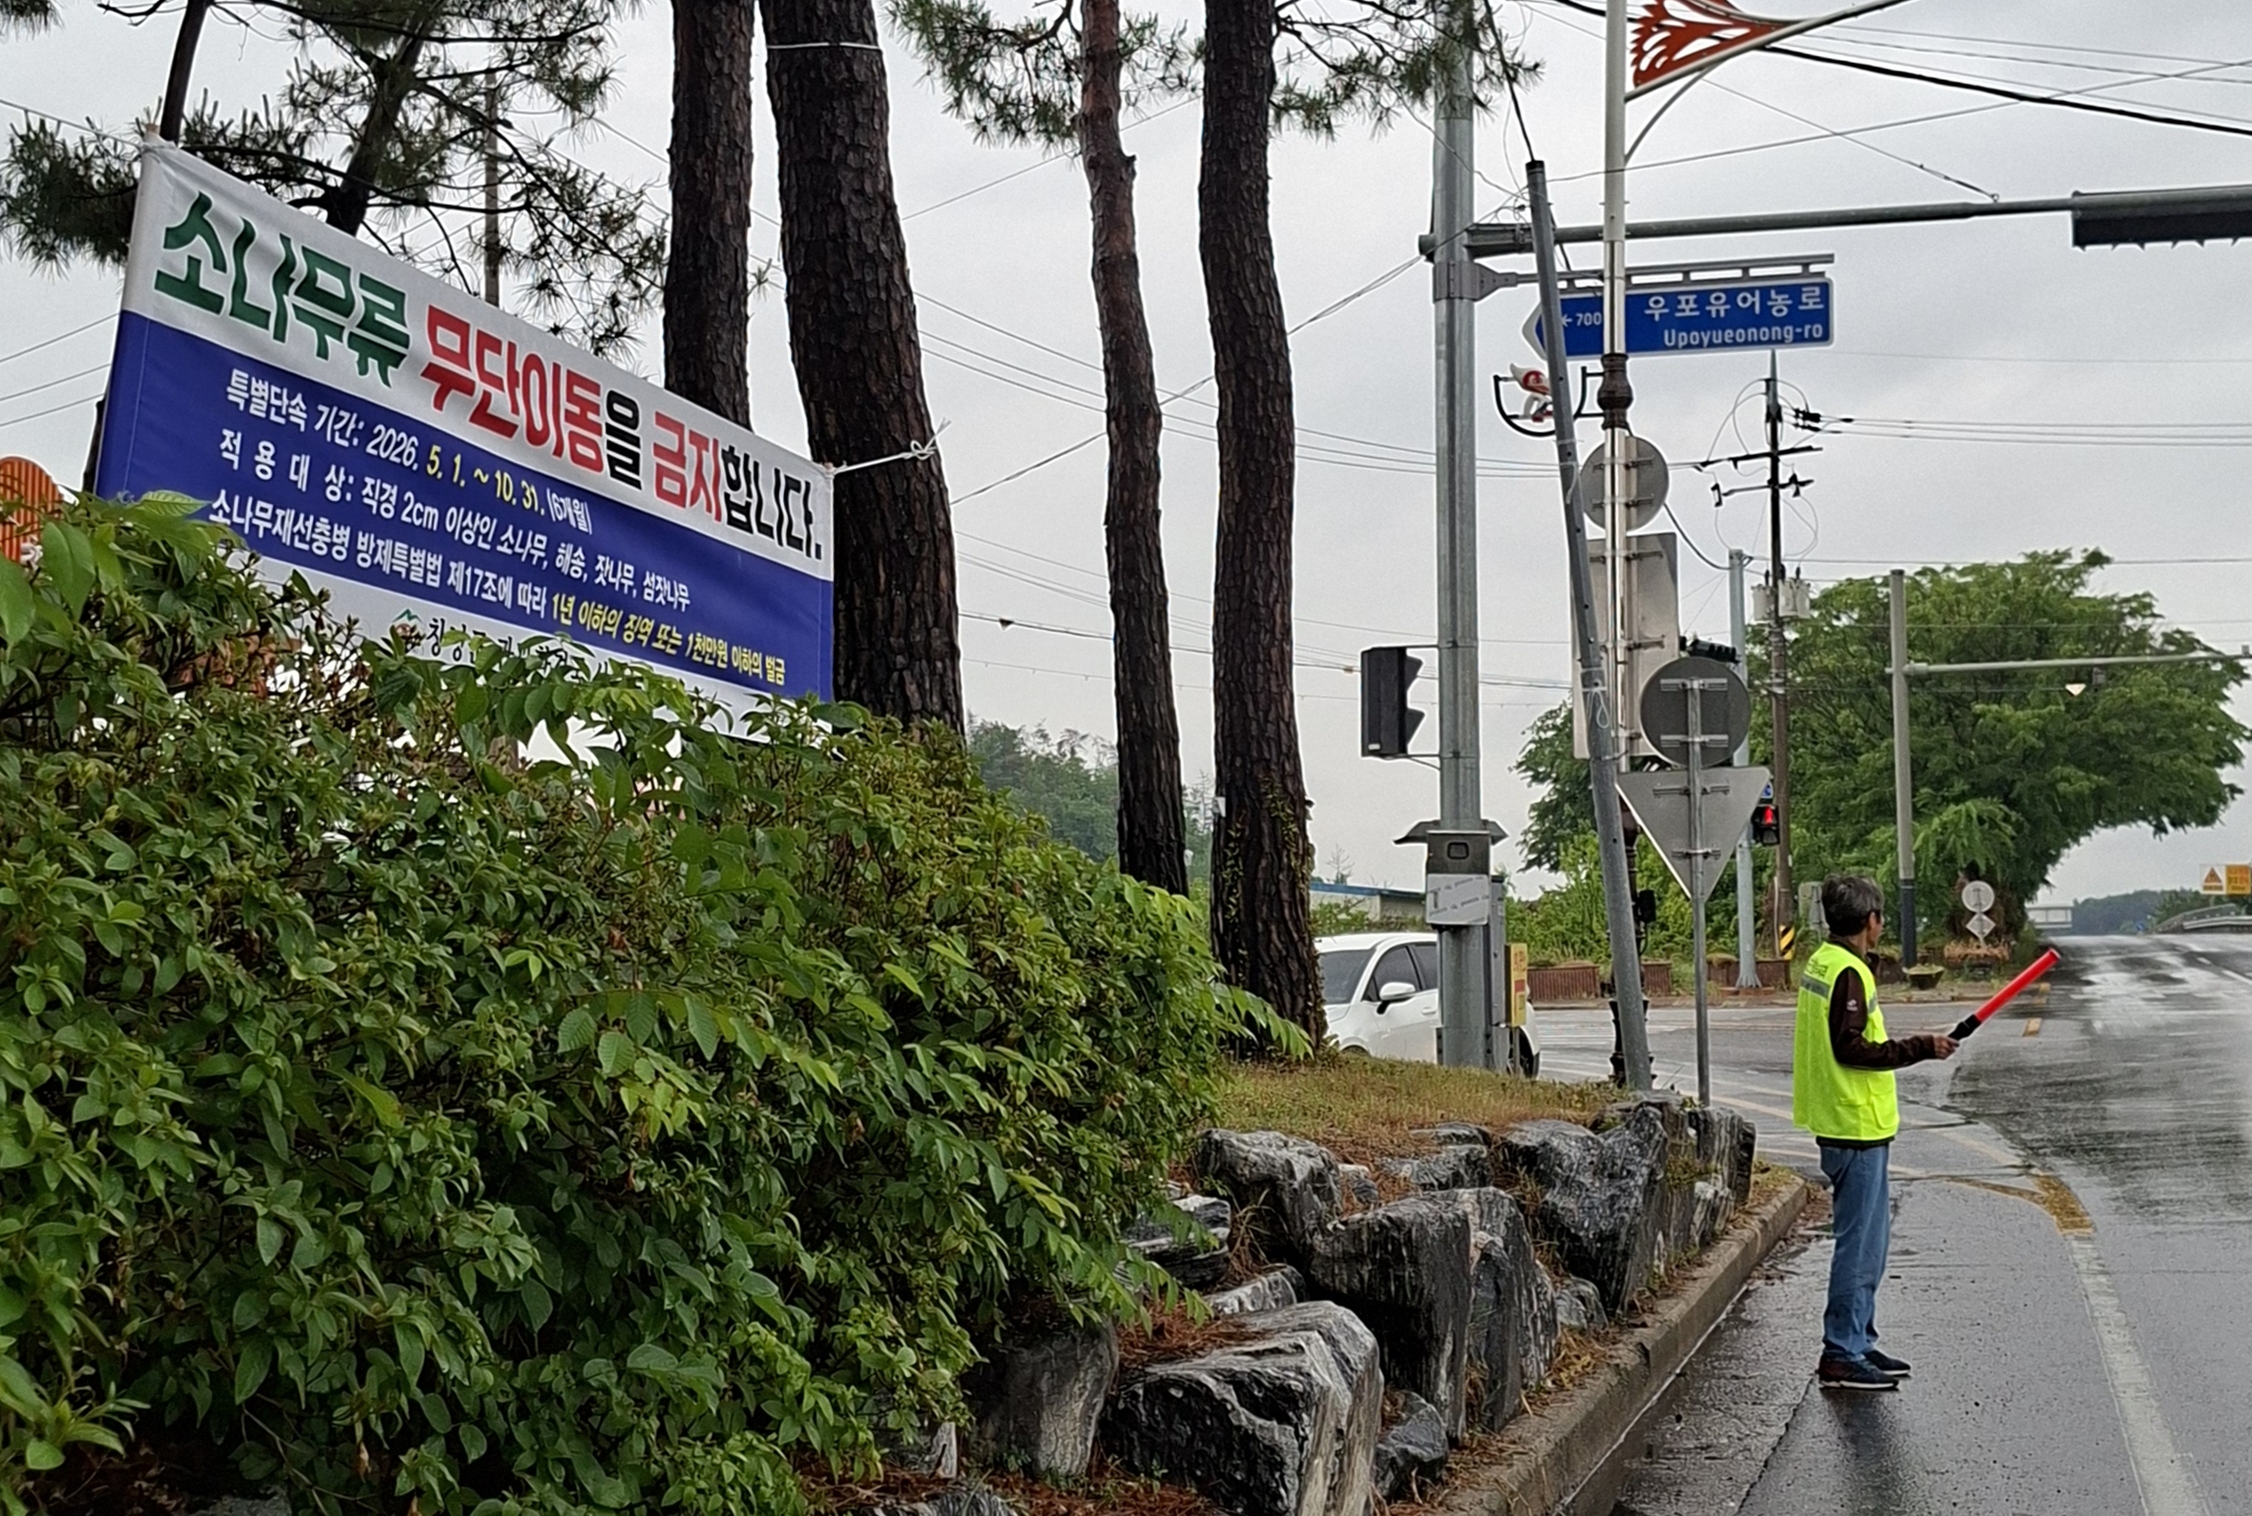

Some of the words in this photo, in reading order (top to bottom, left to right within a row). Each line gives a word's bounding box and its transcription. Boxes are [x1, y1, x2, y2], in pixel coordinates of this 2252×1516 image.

[1644, 286, 1825, 322] 우포유어농로
[1663, 322, 1823, 350] Upoyueonong-ro
[153, 190, 411, 388] 소나무류
[420, 304, 643, 491] 무단이동을
[653, 410, 822, 561] 금지합니다.
[226, 368, 308, 432] 특별단속
[314, 404, 365, 448] 기간:
[365, 423, 419, 471] 2026.
[426, 444, 443, 479] 5.
[452, 453, 466, 487] 1.
[494, 469, 517, 506] 10.
[209, 488, 351, 561] 소나무재선충병
[356, 531, 443, 588] 방제특별법
[447, 560, 514, 610] 제17조에
[517, 581, 548, 619] 따라
[552, 592, 576, 626] 1년
[578, 600, 624, 639] 이하의
[622, 613, 655, 648] 징역
[651, 623, 683, 656] 또는
[685, 632, 728, 669] 1천만원
[731, 645, 763, 680] 이하의
[765, 655, 786, 686] 벌금
[361, 476, 398, 519] 직경
[400, 491, 439, 532] 2cm
[445, 506, 497, 550] 이상인
[496, 524, 548, 570] 소나무,
[555, 542, 588, 583] 해송,
[594, 554, 637, 598] 잣나무,
[643, 570, 691, 612] 섬잣나무
